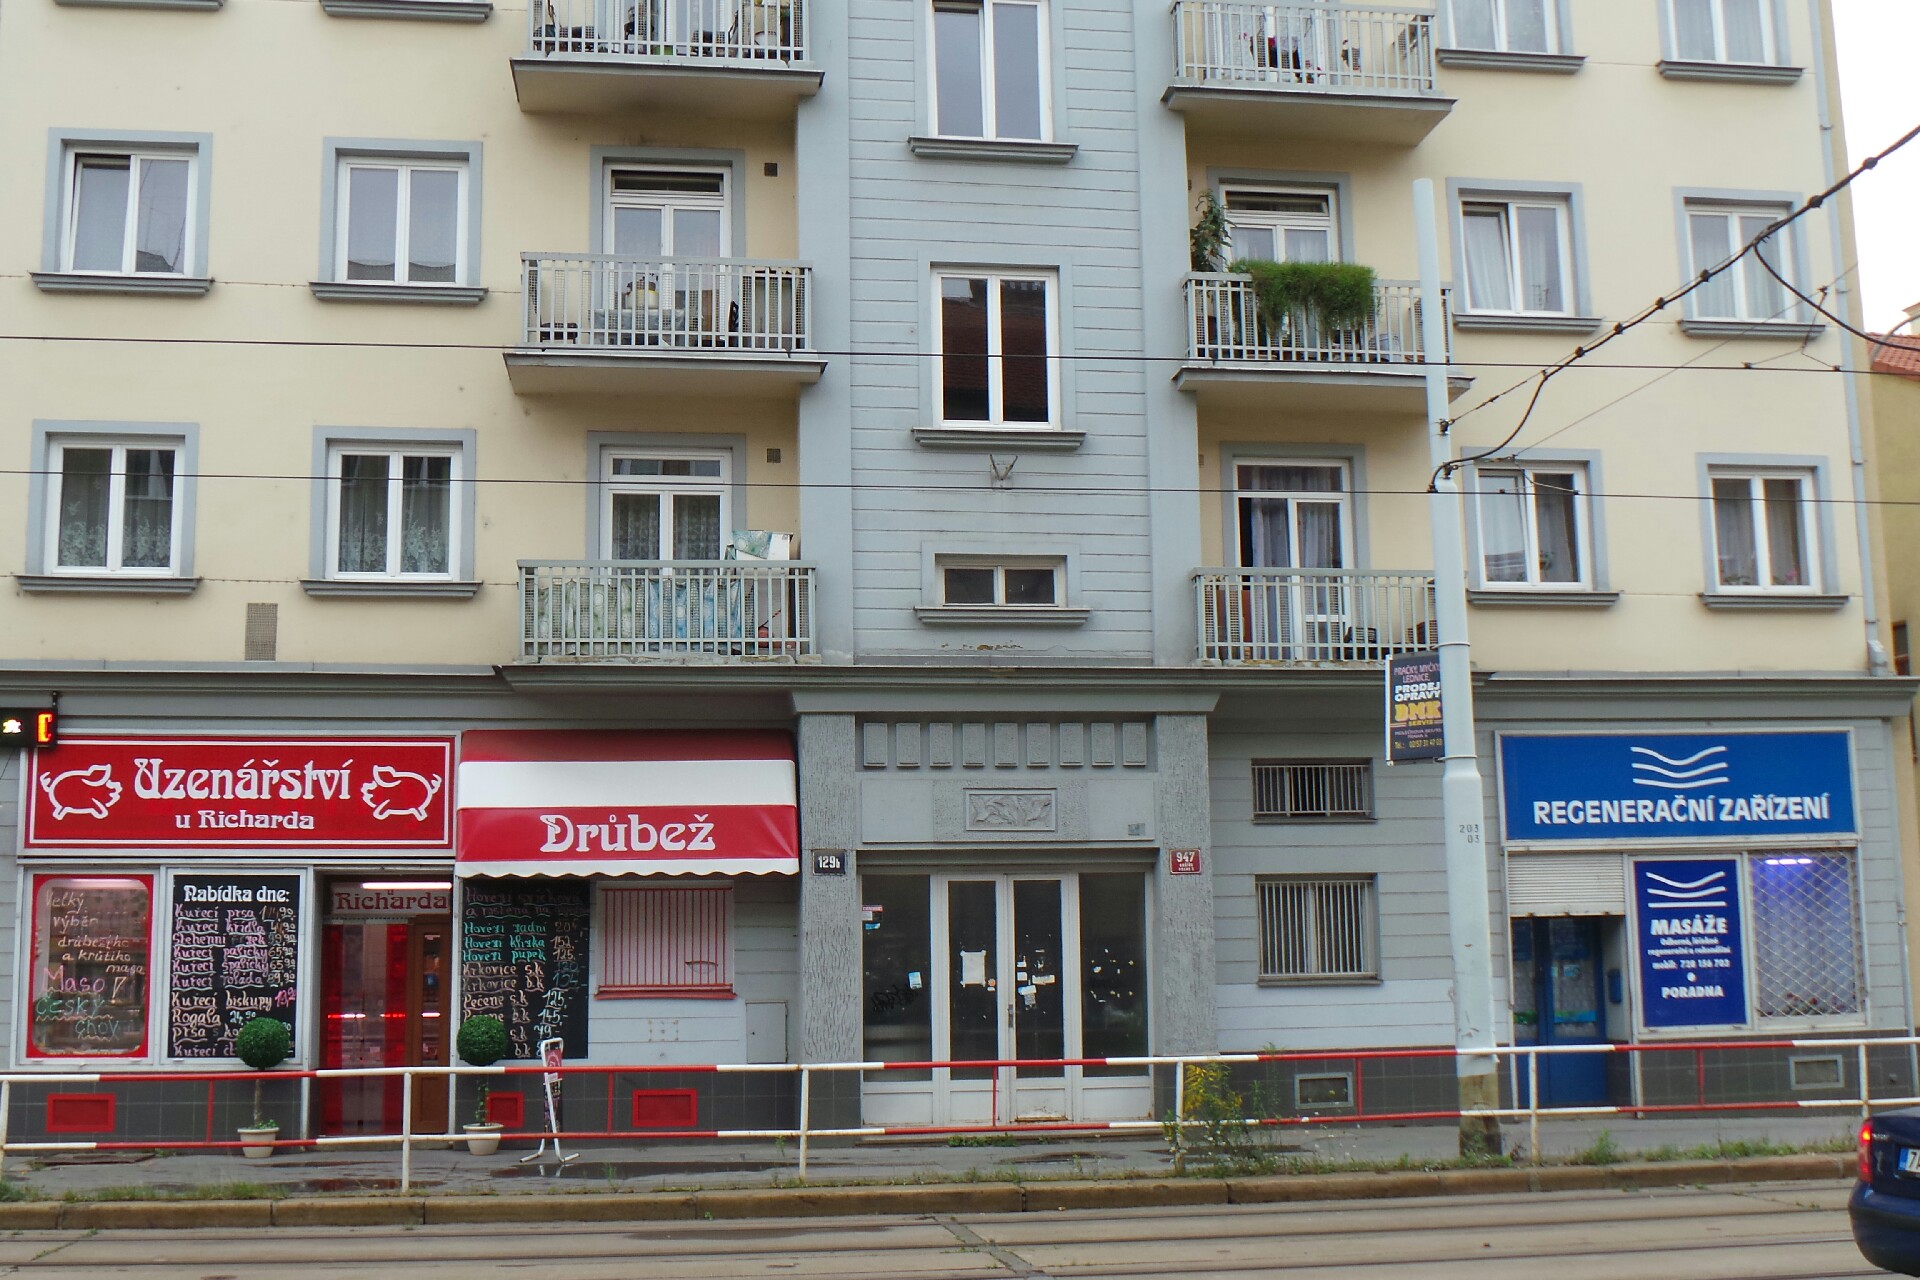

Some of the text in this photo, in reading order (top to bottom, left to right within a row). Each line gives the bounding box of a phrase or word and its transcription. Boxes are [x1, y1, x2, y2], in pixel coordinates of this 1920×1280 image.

[1395, 682, 1440, 694] PRODEJ
[1394, 690, 1441, 702] OPRAVY
[1395, 701, 1441, 721] DMK
[134, 758, 354, 800] Uzenářství
[1534, 793, 1830, 824] REGENERAČNÍ ZAŘÍZENÍ
[175, 809, 315, 830] u Richarda
[539, 813, 716, 853] Drůbež
[1459, 824, 1479, 833] 203
[1468, 835, 1480, 844] 03
[1176, 851, 1195, 863] 947
[183, 885, 290, 902] Nabídka dne:
[335, 890, 448, 910] Richarda
[227, 909, 256, 921] prsa
[1650, 914, 1728, 935] MASÁŽE
[62, 952, 74, 961] a
[511, 949, 546, 964] pupek
[463, 961, 516, 976] Krkovice
[41, 965, 105, 993] Maso
[463, 977, 516, 991] Krkovice
[1661, 985, 1725, 999] PORADNA
